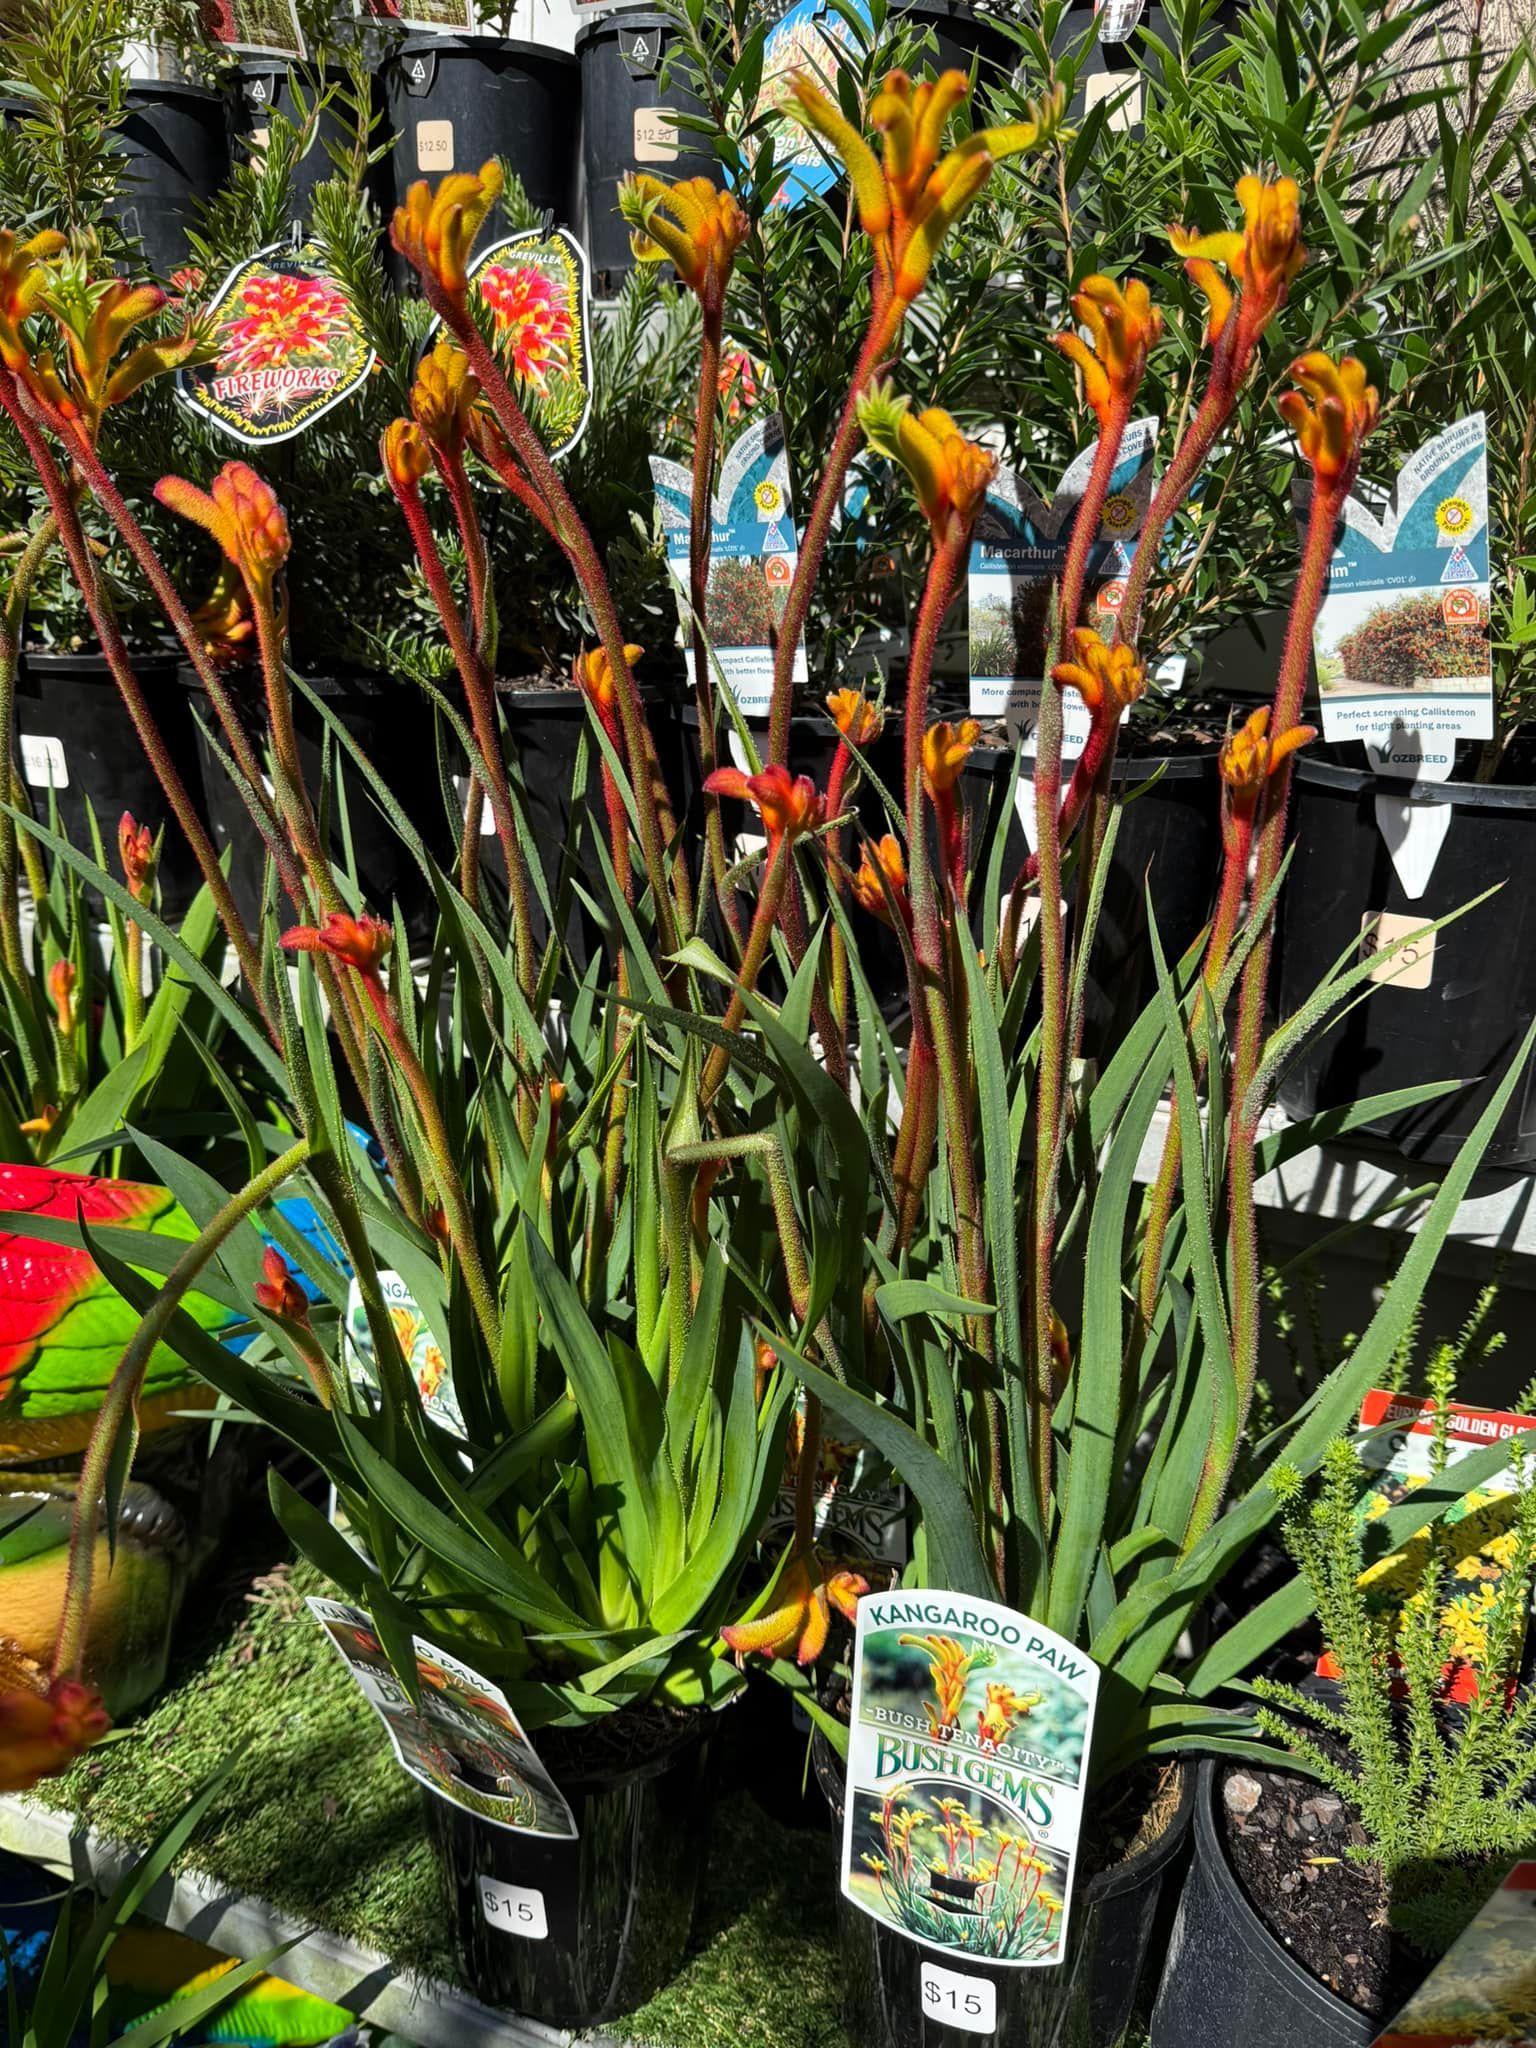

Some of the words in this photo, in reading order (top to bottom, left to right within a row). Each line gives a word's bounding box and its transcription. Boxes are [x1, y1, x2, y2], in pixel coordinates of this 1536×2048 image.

[636, 129, 672, 141] $12.50
[418, 139, 448, 153] $12.50
[511, 251, 562, 265] GREVILLEA
[213, 367, 340, 400] FIREWORKS
[1413, 447, 1437, 475] NATIVE
[1436, 426, 1469, 453] SHRUBS
[1420, 451, 1450, 482] GROUND
[1449, 432, 1483, 455] COVERS
[1440, 501, 1470, 513] Drought
[1441, 519, 1470, 533] Tolerant
[718, 656, 745, 667] ompact
[740, 695, 772, 705] OZBRE
[981, 688, 1005, 697] More
[1006, 688, 1041, 698] compac
[1336, 709, 1371, 720] Perfect
[1372, 707, 1420, 719] screening
[1420, 707, 1477, 718] Callistemon
[1355, 723, 1369, 732] for
[1370, 722, 1394, 732] tight
[1393, 722, 1435, 732] planting
[1435, 722, 1462, 731] areas
[1391, 754, 1449, 764] OZBREED
[1385, 1404, 1441, 1426] EURYOP
[1446, 1415, 1498, 1438] GOLDEN
[870, 1603, 1021, 1645] KANGAROO
[1025, 1636, 1088, 1681] PAW
[440, 1658, 493, 1693] PAW
[484, 1891, 534, 1922] $15
[924, 1980, 982, 2015] $15
